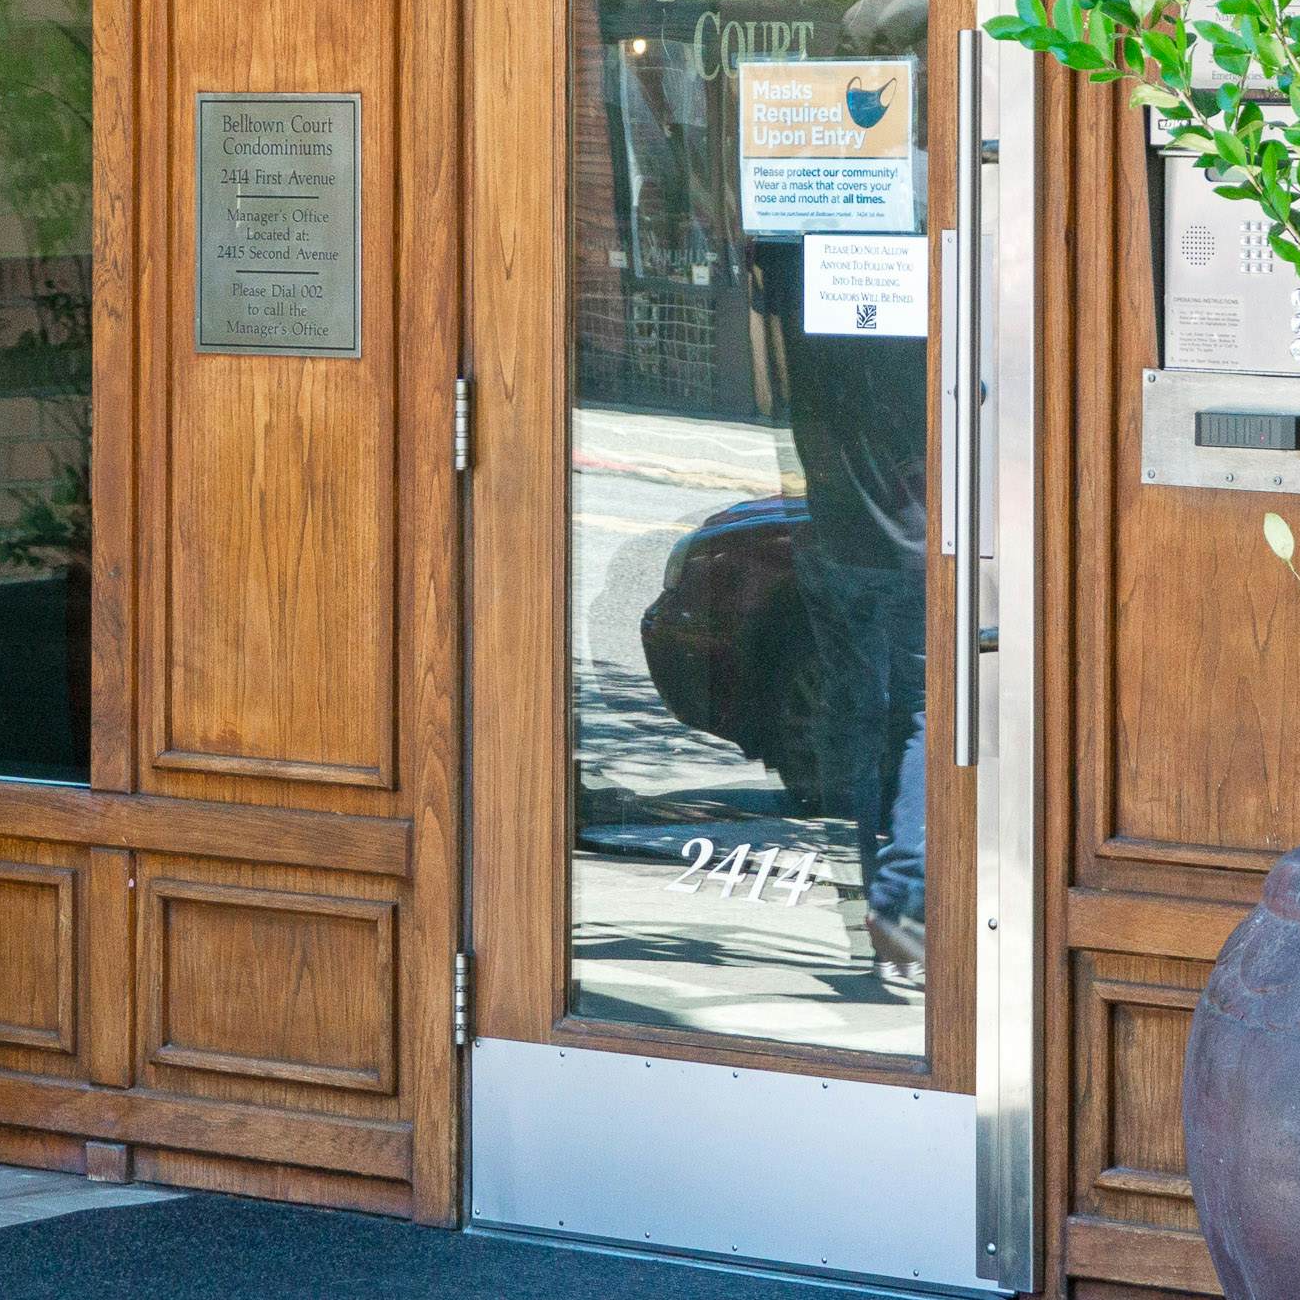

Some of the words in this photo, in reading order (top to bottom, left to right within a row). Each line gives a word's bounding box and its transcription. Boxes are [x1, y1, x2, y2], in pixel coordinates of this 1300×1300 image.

[753, 80, 812, 99] Masks
[754, 103, 843, 124] Required
[223, 114, 284, 134] Belltown
[291, 115, 333, 133] Court
[754, 126, 805, 148] Upon
[812, 126, 866, 149] Entry
[223, 137, 332, 157] Condominiums
[220, 169, 249, 185] 2414
[255, 169, 282, 185] First
[288, 170, 335, 186] Avenue
[754, 167, 784, 177] Please
[787, 167, 820, 180] protect
[823, 168, 839, 177] our
[842, 167, 898, 179] community!
[754, 179, 779, 190] Wear
[789, 180, 813, 190] mask
[816, 180, 834, 190] that
[837, 181, 867, 191] covers
[870, 182, 891, 193] your
[754, 194, 777, 203] nose
[779, 193, 795, 203] and
[798, 193, 828, 204] mouth
[831, 194, 840, 204] at
[843, 193, 853, 204] all
[856, 193, 886, 204] times.
[227, 208, 287, 225] Manager's
[292, 209, 329, 223] Office
[246, 227, 290, 241] Located
[296, 230, 309, 242] at:
[217, 245, 245, 259] 2415
[250, 246, 290, 260] Second
[296, 248, 339, 261] Avenue
[232, 283, 266, 298] Please
[272, 284, 296, 298] Dial
[300, 284, 323, 299] 002
[248, 303, 259, 315] to
[264, 302, 284, 316] call
[289, 303, 307, 317] the
[227, 321, 287, 339] Manager's
[292, 322, 329, 337] Office
[664, 838, 820, 908] 2414
